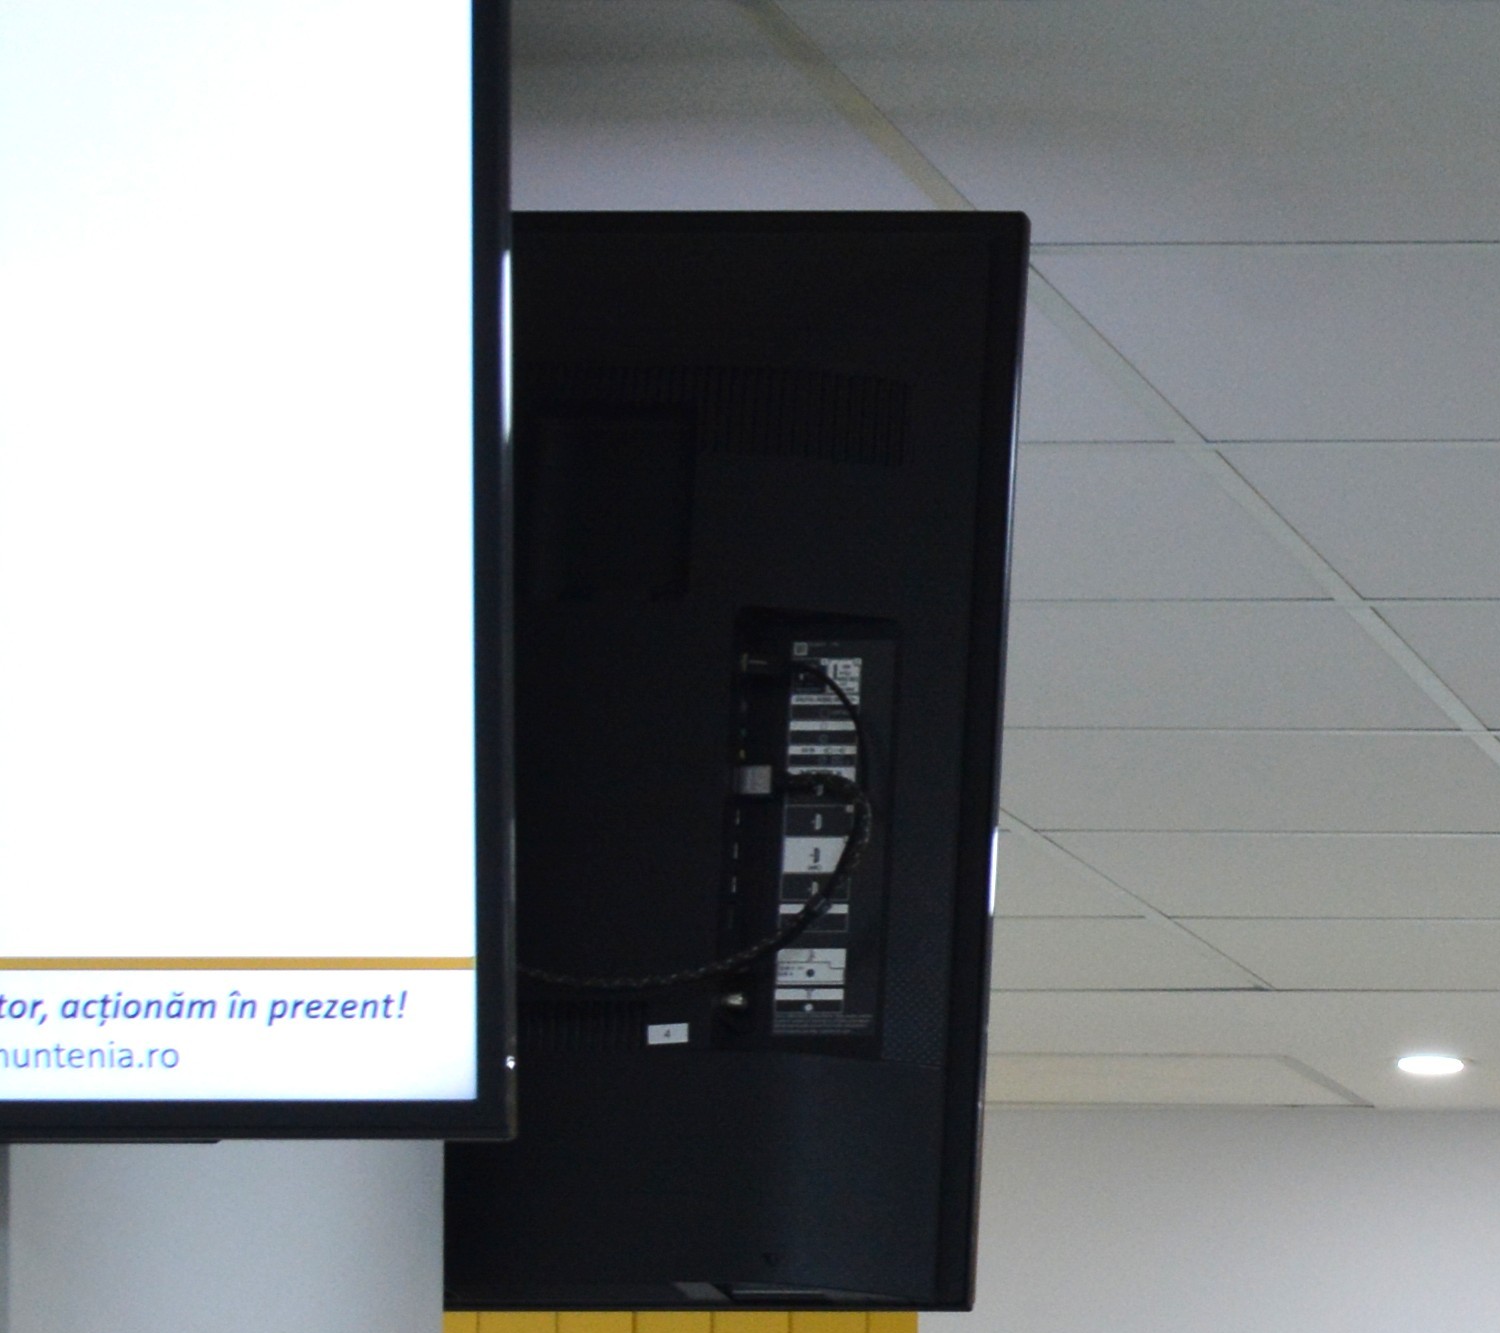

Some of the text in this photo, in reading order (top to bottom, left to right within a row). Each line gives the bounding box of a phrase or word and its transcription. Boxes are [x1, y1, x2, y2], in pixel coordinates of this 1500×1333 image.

[60, 992, 216, 1026] acționăm
[228, 990, 256, 1018] în
[267, 991, 407, 1026] prezent!
